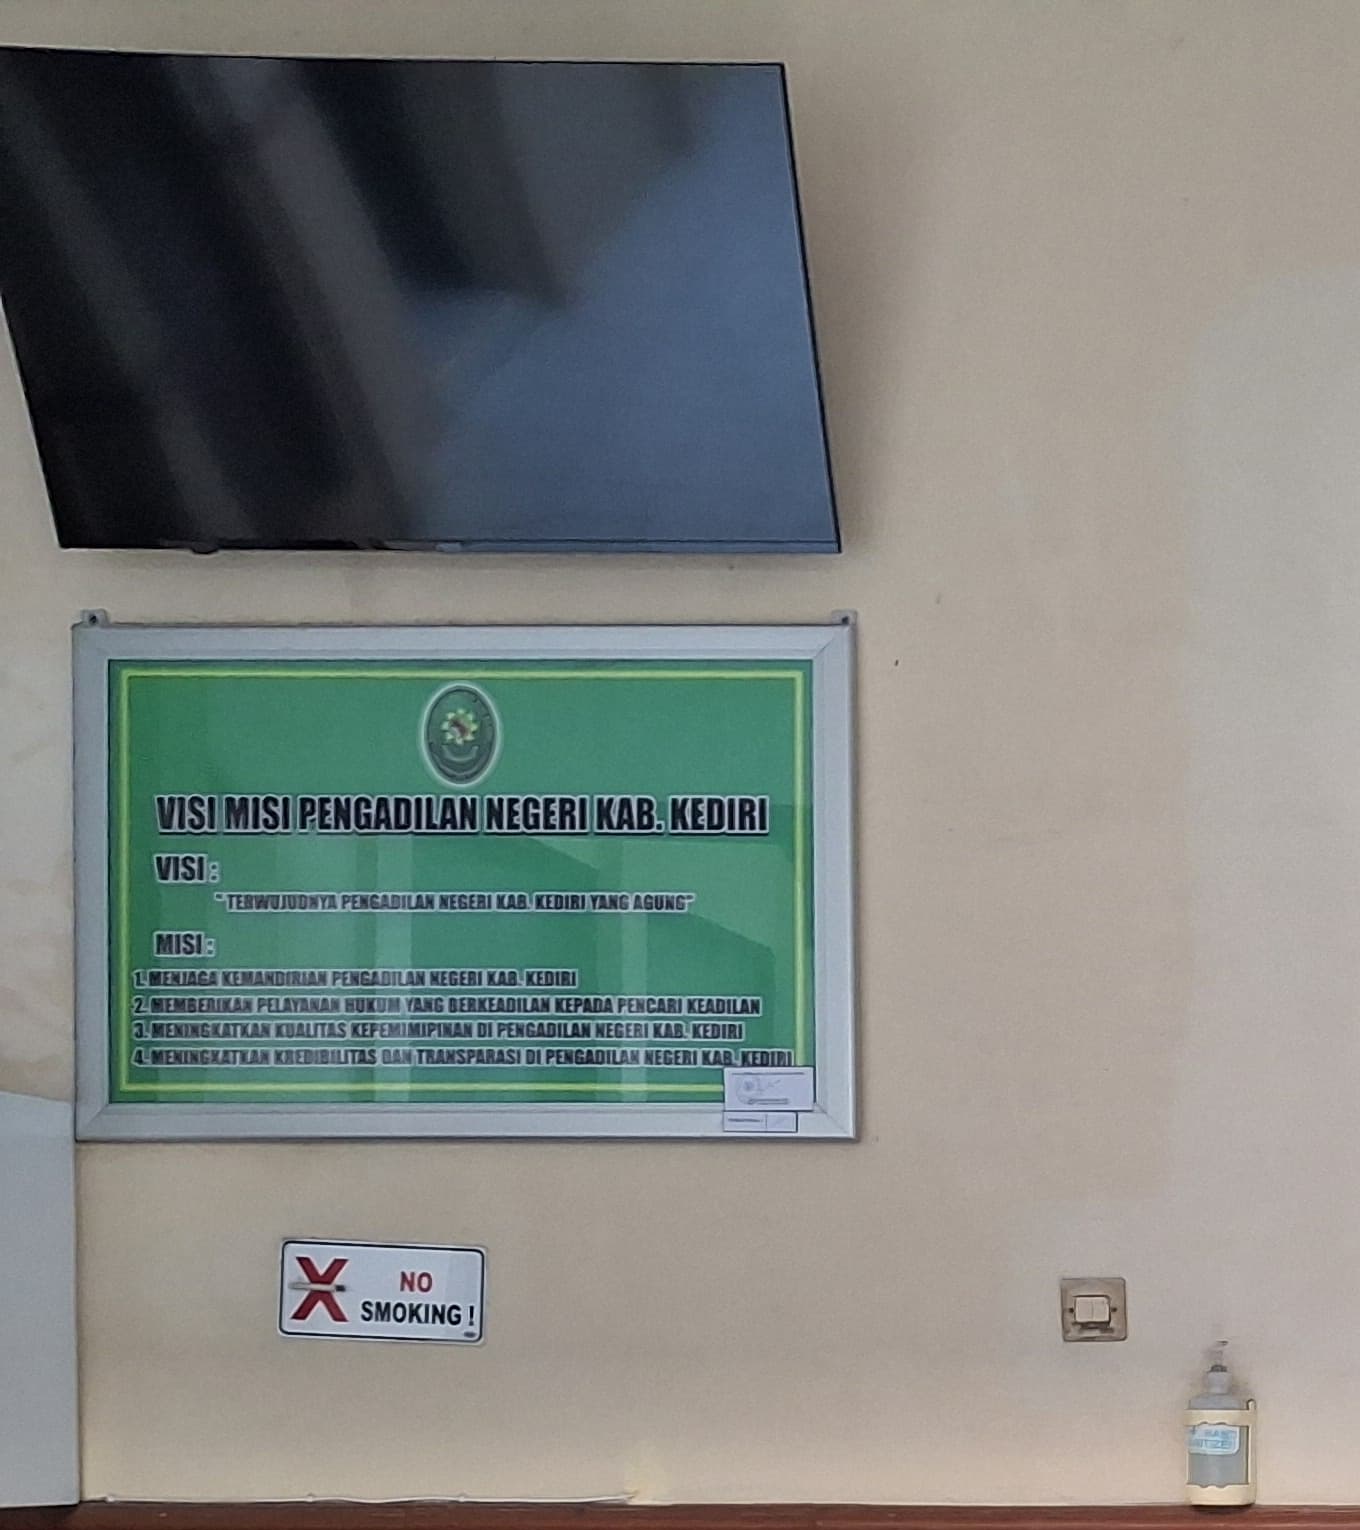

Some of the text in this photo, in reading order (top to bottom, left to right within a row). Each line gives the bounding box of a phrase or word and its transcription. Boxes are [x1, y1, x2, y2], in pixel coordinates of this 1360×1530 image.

[155, 795, 769, 834] VISI MISI PENGADILAN NEGERI KAB. KEDIRI
[340, 892, 435, 912] PENGADILAN
[437, 892, 493, 912] NEGERI
[495, 892, 532, 912] KAB.
[534, 892, 587, 912] KEDIRI
[588, 892, 631, 912] YANG
[133, 969, 578, 989] 1. MENJAGA KEMANDIRIAN PENGADILAN NEGERI KAB. KEDIRI
[133, 995, 762, 1016] 2. MEMBERIKAN PELAYANAN HUKUM YANG BERKEADILAN KEPADA PENCARI KEADILAN
[150, 1020, 272, 1040] MENINGKATKAN
[274, 1020, 347, 1040] KUALITAS
[476, 1020, 493, 1040] DI
[495, 1020, 592, 1040] PENGADILAN
[594, 1020, 649, 1040] NEGERI
[651, 1020, 689, 1041] KAB.
[690, 1021, 745, 1041] KEDIRI
[150, 1047, 271, 1066] MENINGKATKAN
[273, 1047, 377, 1066] KREDIBILITAS
[381, 1047, 412, 1066] DAN
[524, 1047, 542, 1066] DI
[544, 1047, 640, 1066] PENGADILAN
[643, 1047, 698, 1066] NEGERI
[700, 1047, 738, 1067] KAB.
[739, 1048, 794, 1067] KEDIRI
[400, 1271, 433, 1293] NO
[361, 1301, 462, 1326] SMOKING
